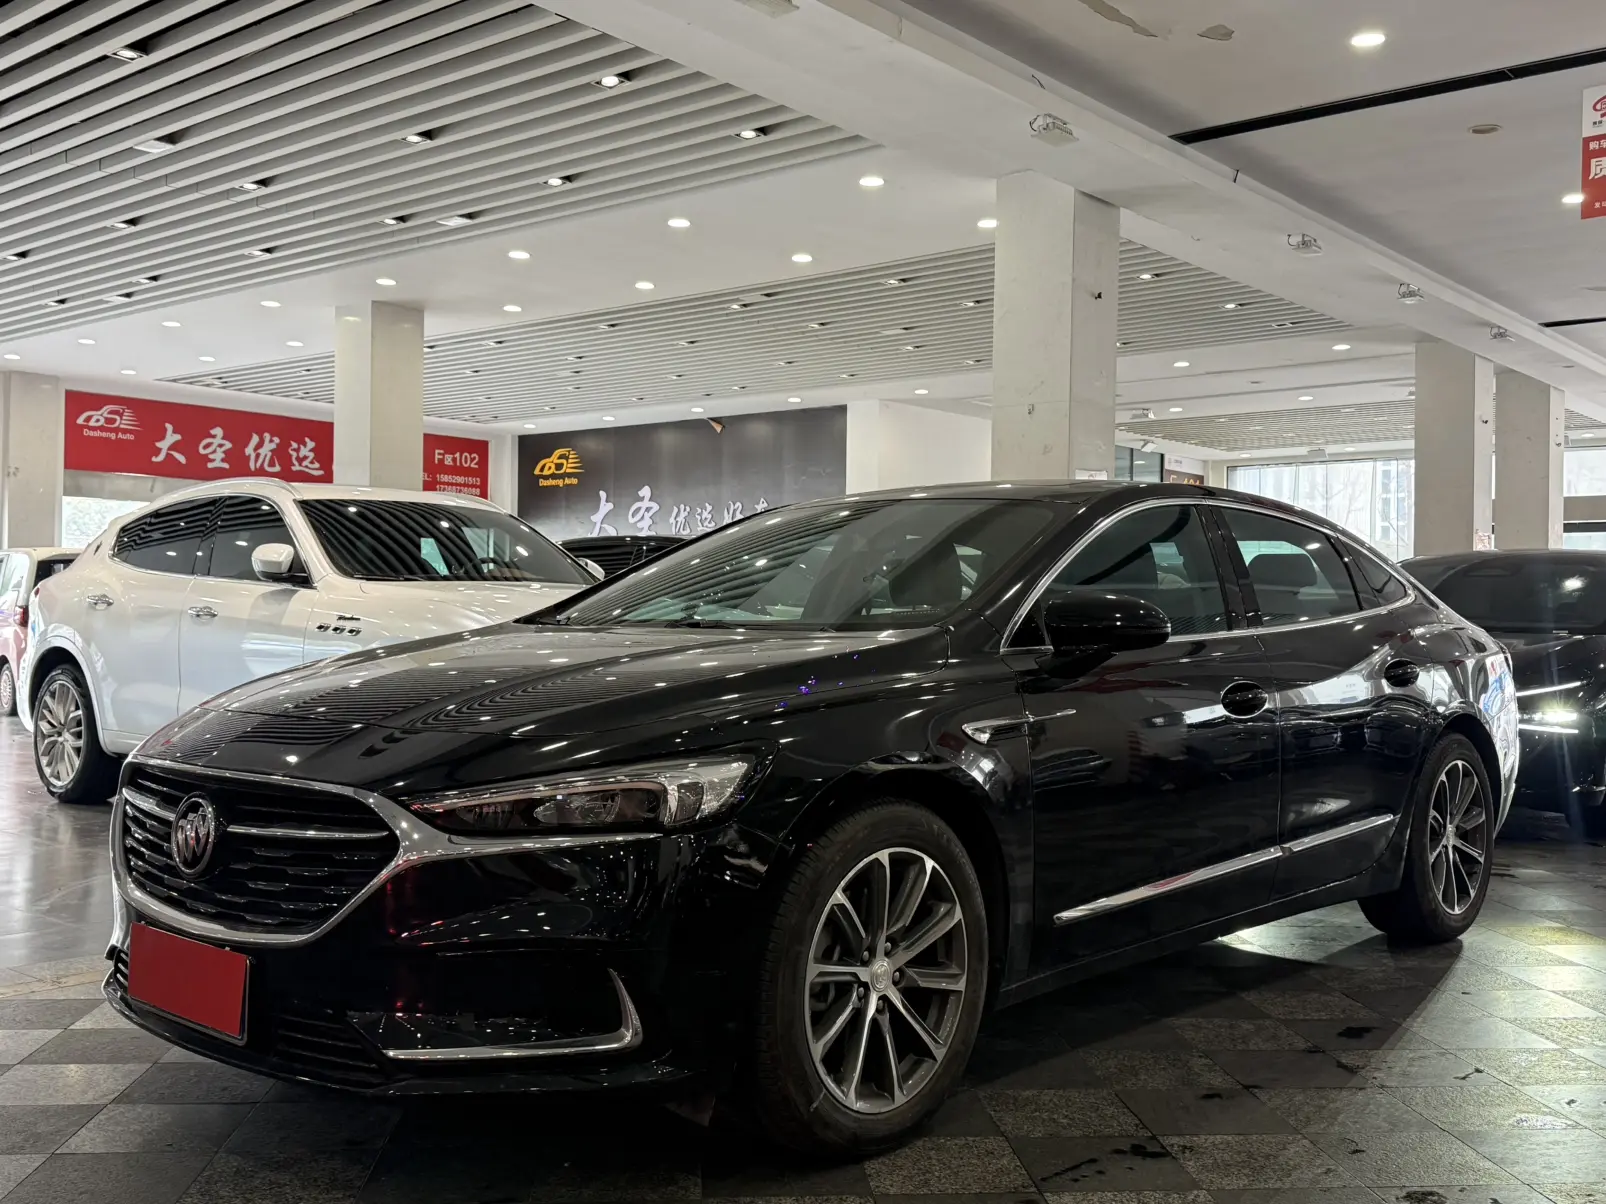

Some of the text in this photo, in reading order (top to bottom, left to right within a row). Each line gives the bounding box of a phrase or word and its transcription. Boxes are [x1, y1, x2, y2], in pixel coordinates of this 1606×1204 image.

[83, 428, 135, 440] Dasheng Auto
[151, 422, 325, 476] 大圣优选
[434, 448, 479, 469] F区102
[538, 476, 578, 487] Dasheng Auto
